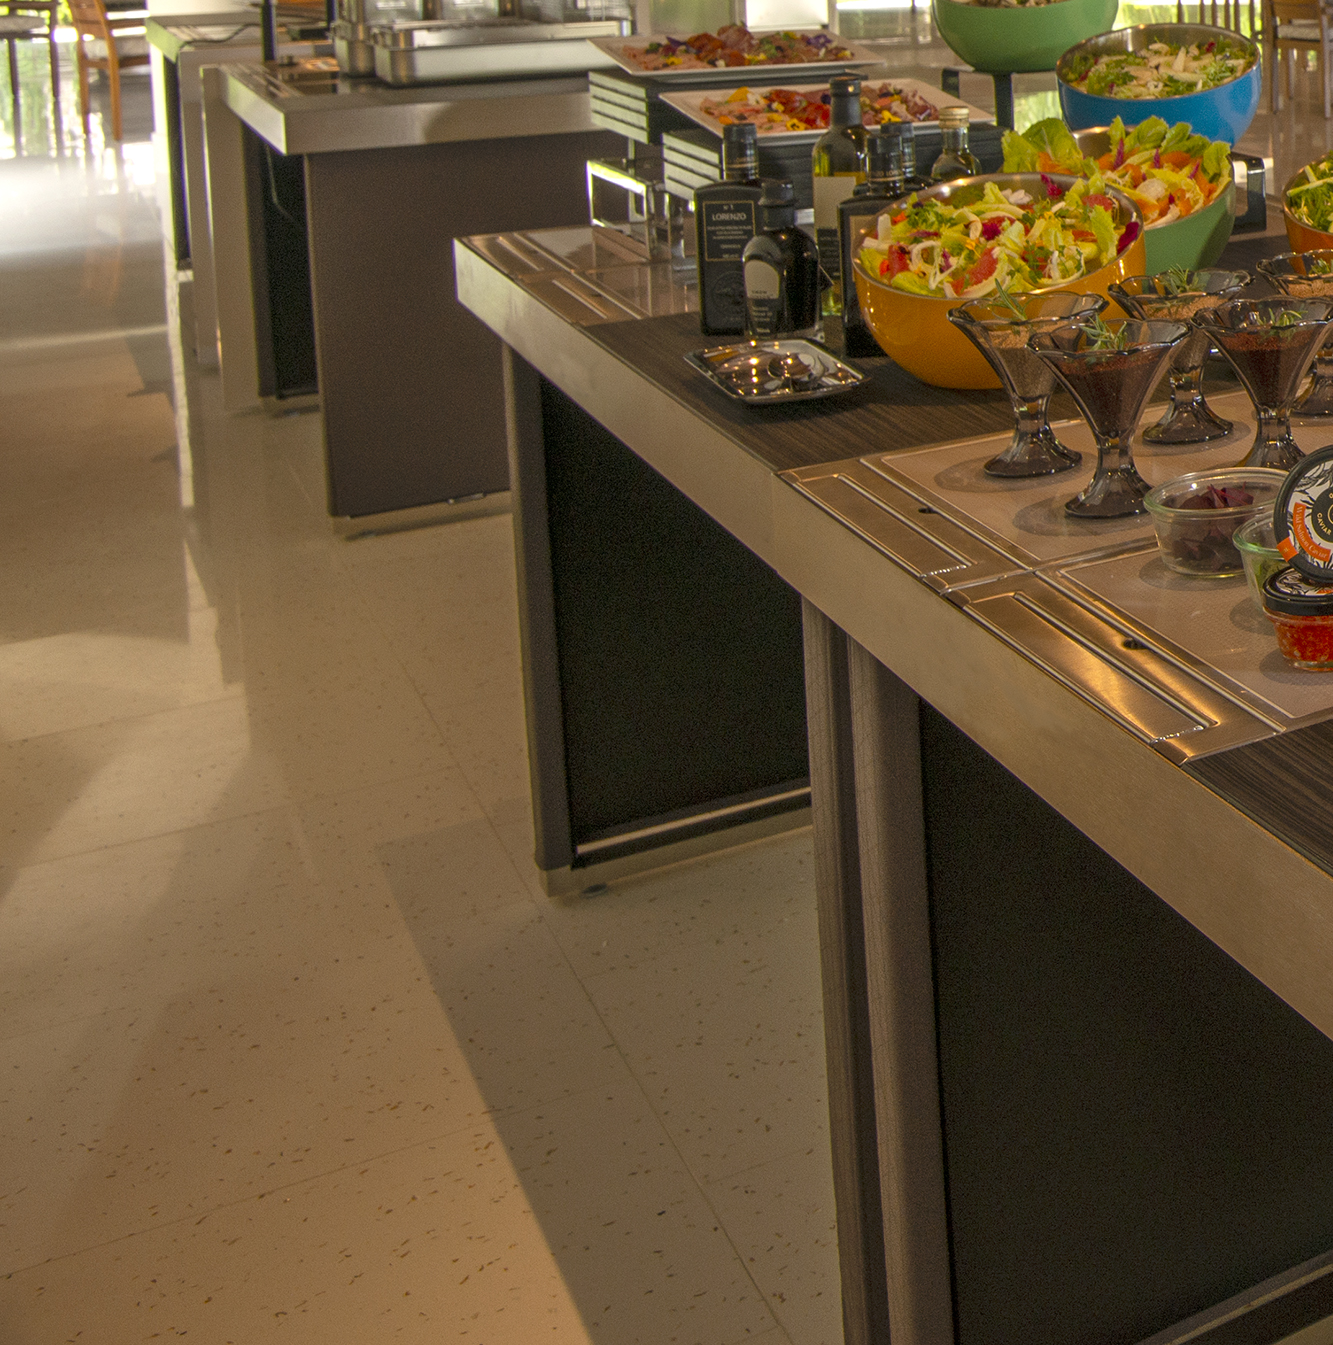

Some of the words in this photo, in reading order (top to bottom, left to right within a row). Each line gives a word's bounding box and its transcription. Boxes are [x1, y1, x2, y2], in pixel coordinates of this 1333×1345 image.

[712, 213, 747, 221] LORENZO
[1295, 506, 1303, 524] Wild
[1317, 512, 1332, 535] CAVIAR
